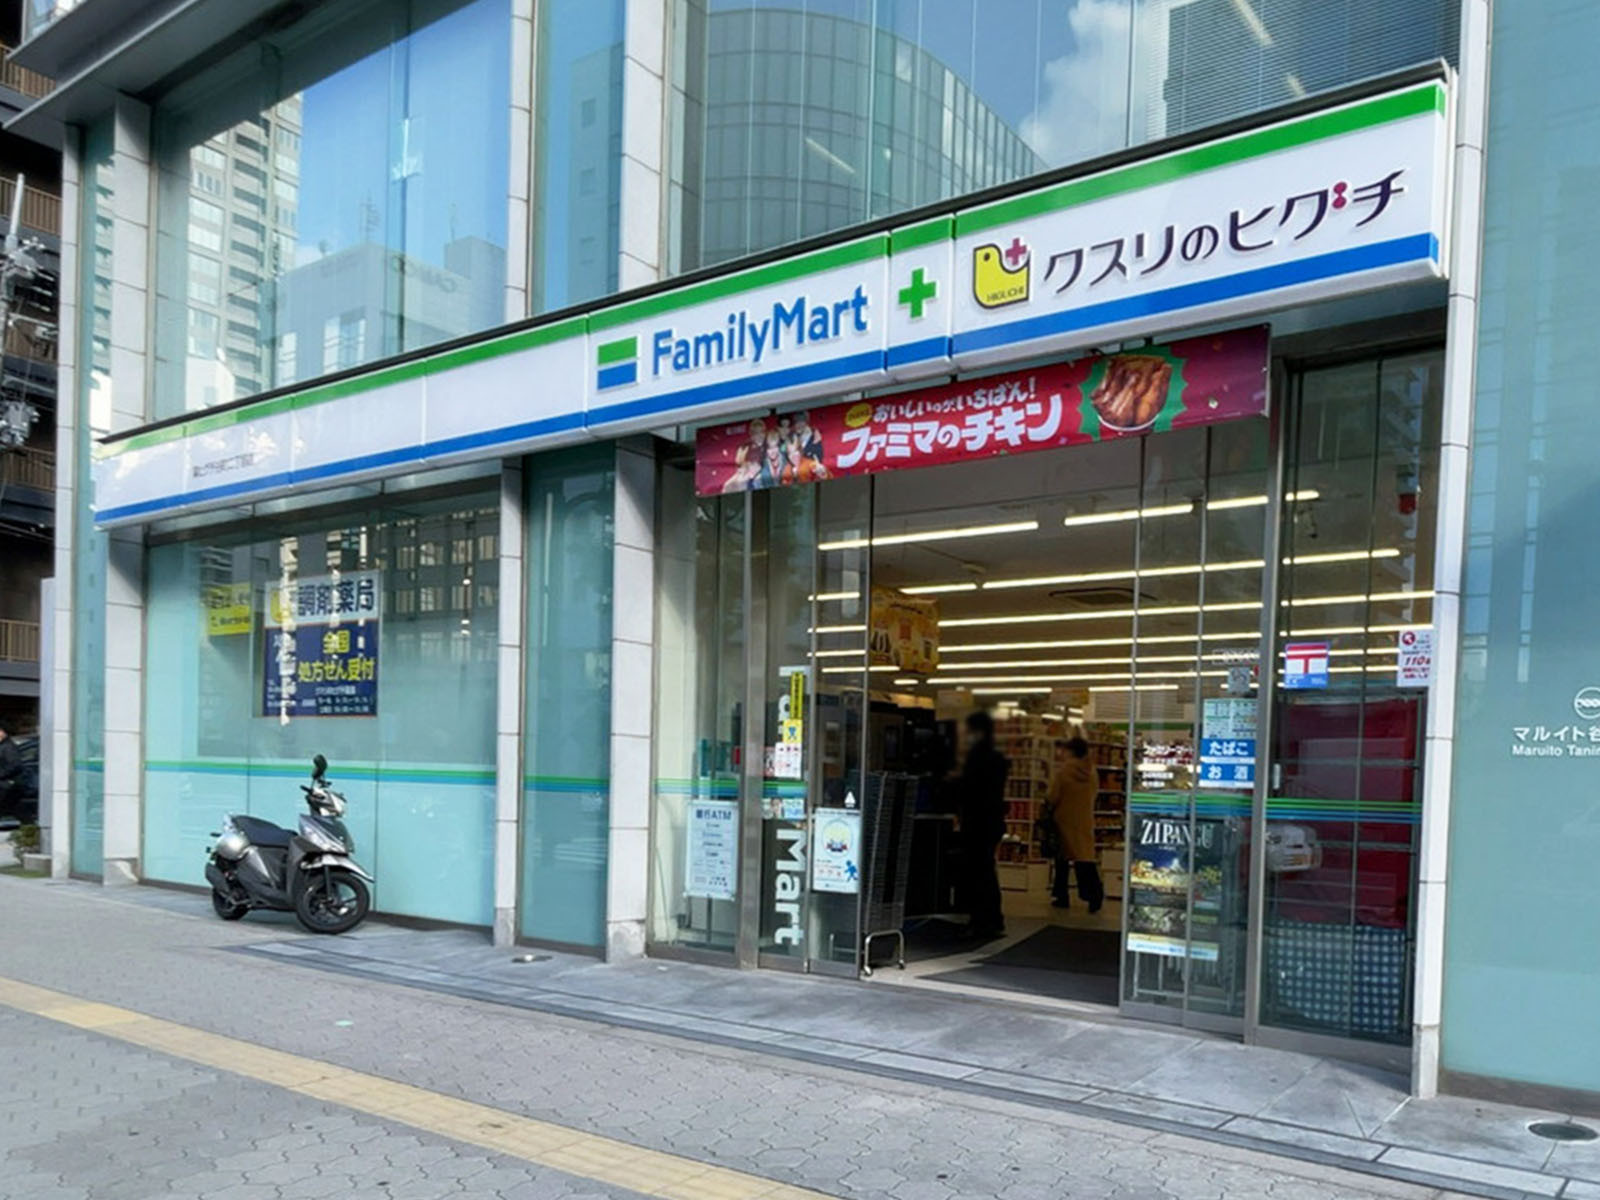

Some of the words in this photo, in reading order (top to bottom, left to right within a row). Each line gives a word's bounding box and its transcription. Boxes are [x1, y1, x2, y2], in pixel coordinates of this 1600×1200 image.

[1043, 169, 1405, 294] クスリのヒグチ
[652, 285, 870, 377] FamilyMart
[836, 393, 1063, 468] ファミマのチキン
[298, 657, 376, 683] 処方せん受付
[1209, 740, 1249, 757] たばこ
[1512, 744, 1563, 757] Maruito
[1140, 818, 1216, 849] ZIPANU
